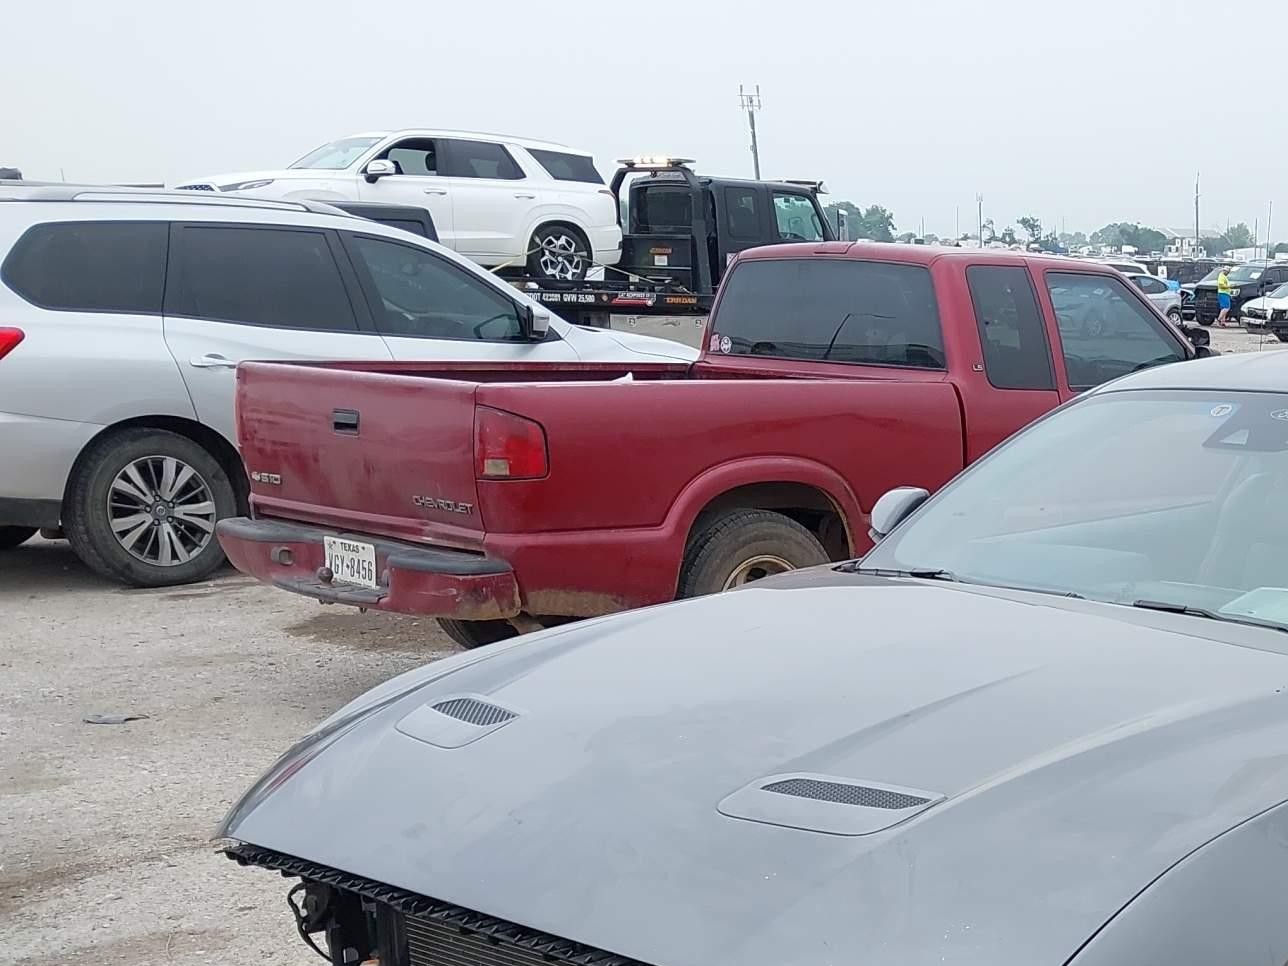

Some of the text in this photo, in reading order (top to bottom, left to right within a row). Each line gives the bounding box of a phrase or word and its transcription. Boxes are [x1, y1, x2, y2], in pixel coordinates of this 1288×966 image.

[260, 472, 281, 485] S10
[412, 495, 473, 515] CHEVROLET
[340, 542, 360, 554] TEXAS
